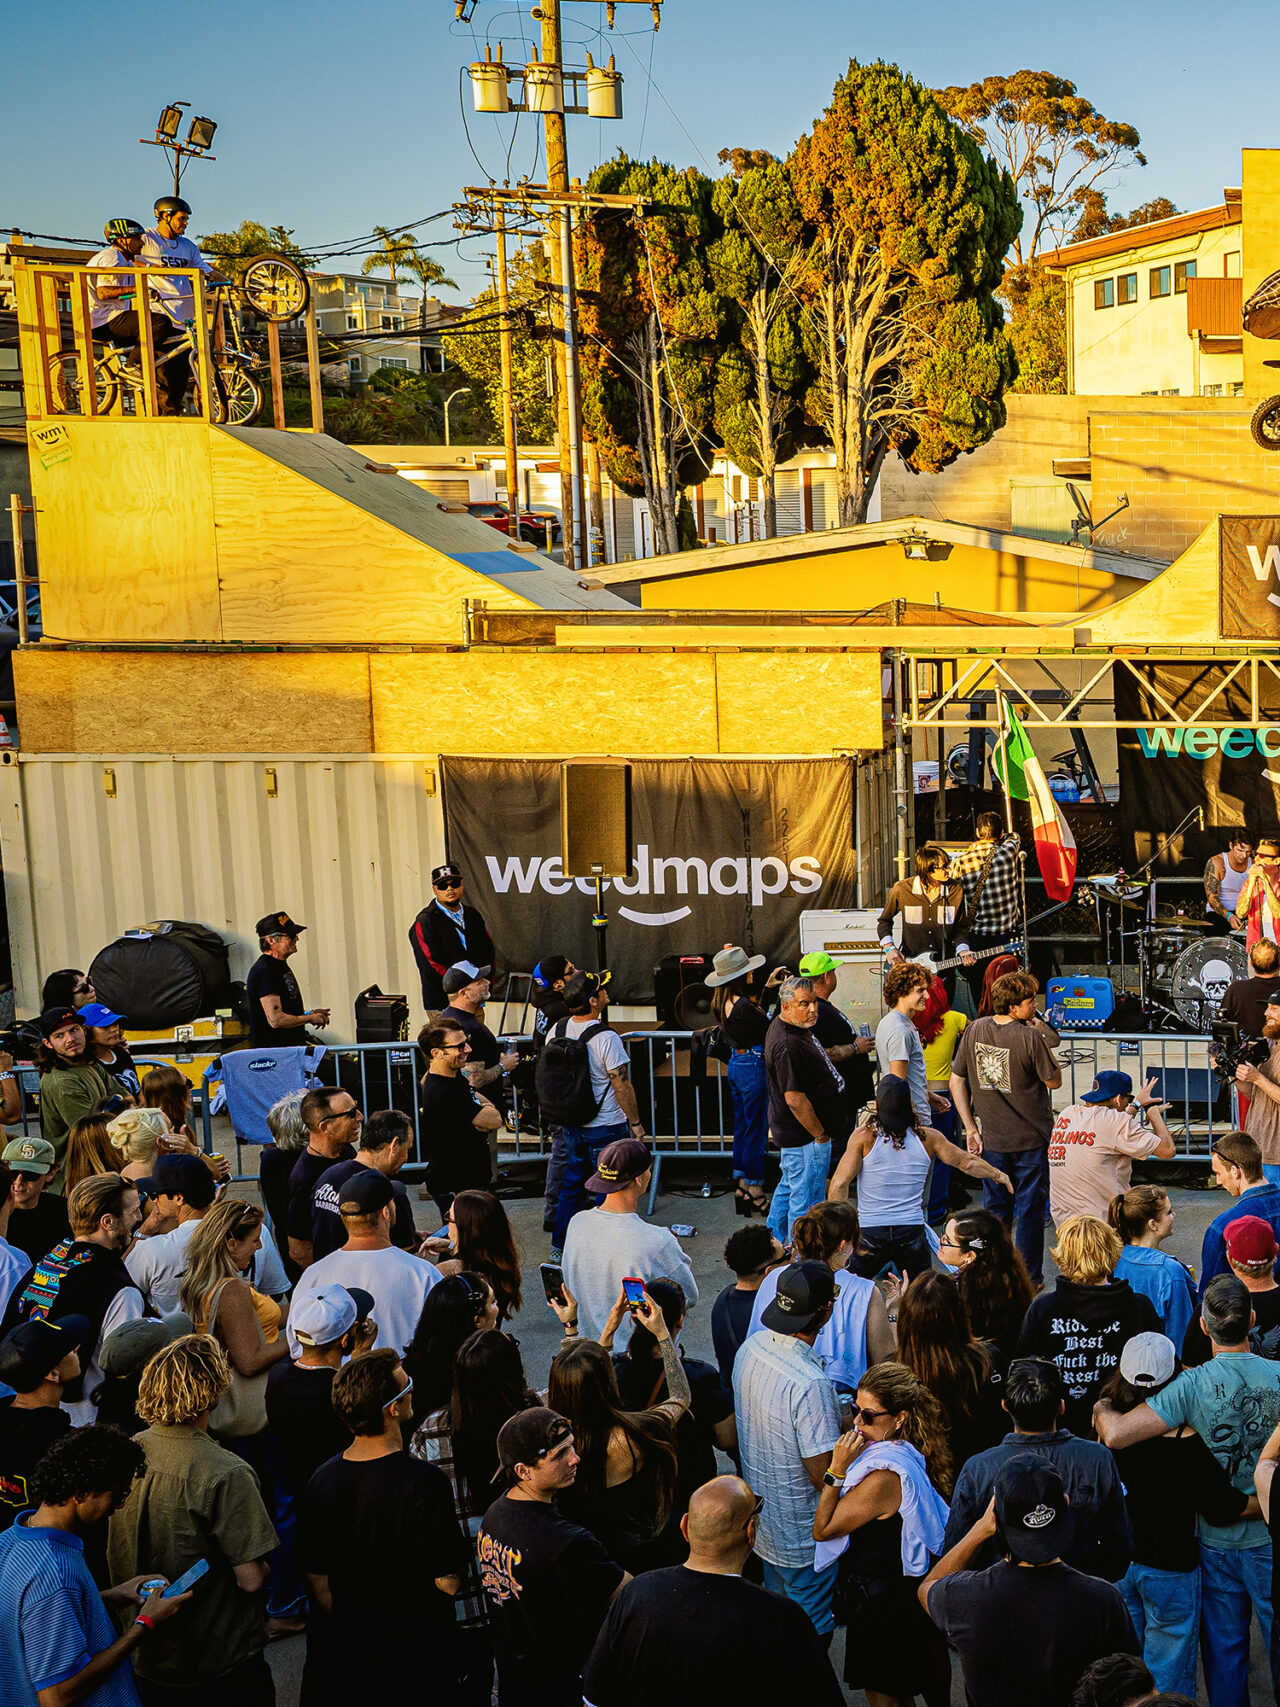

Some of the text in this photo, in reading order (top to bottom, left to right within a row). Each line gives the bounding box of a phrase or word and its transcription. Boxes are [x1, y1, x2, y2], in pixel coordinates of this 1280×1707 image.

[37, 427, 61, 440] wm
[485, 844, 824, 906] wedmaps
[249, 1061, 277, 1070] slackr
[1063, 1335, 1104, 1352] Best
[1095, 1351, 1118, 1367] the
[1062, 1369, 1100, 1384] Rest
